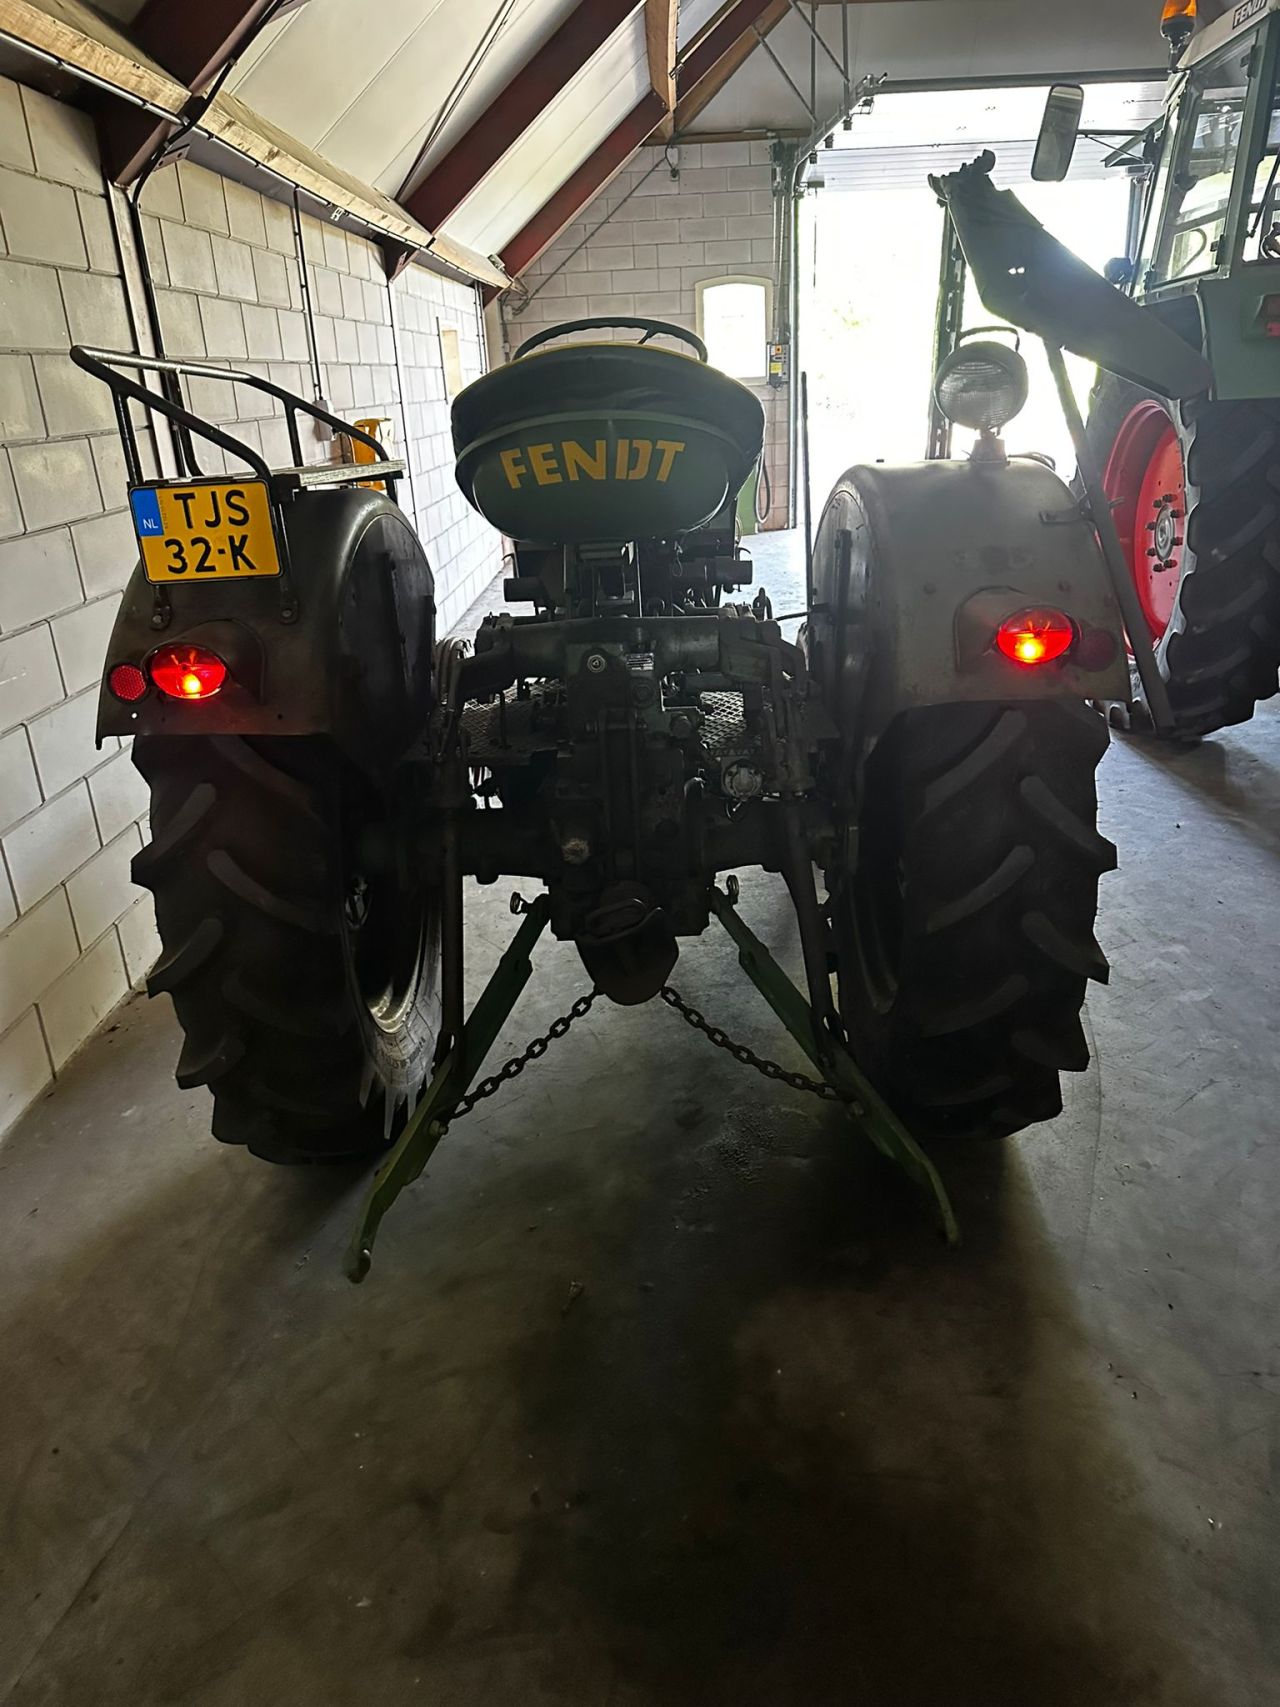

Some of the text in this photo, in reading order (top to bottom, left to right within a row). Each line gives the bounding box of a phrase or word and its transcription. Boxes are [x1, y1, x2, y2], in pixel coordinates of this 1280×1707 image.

[499, 439, 686, 490] FENDT
[143, 518, 159, 530] NL
[173, 489, 250, 529] TJS
[164, 534, 257, 574] 32-K
